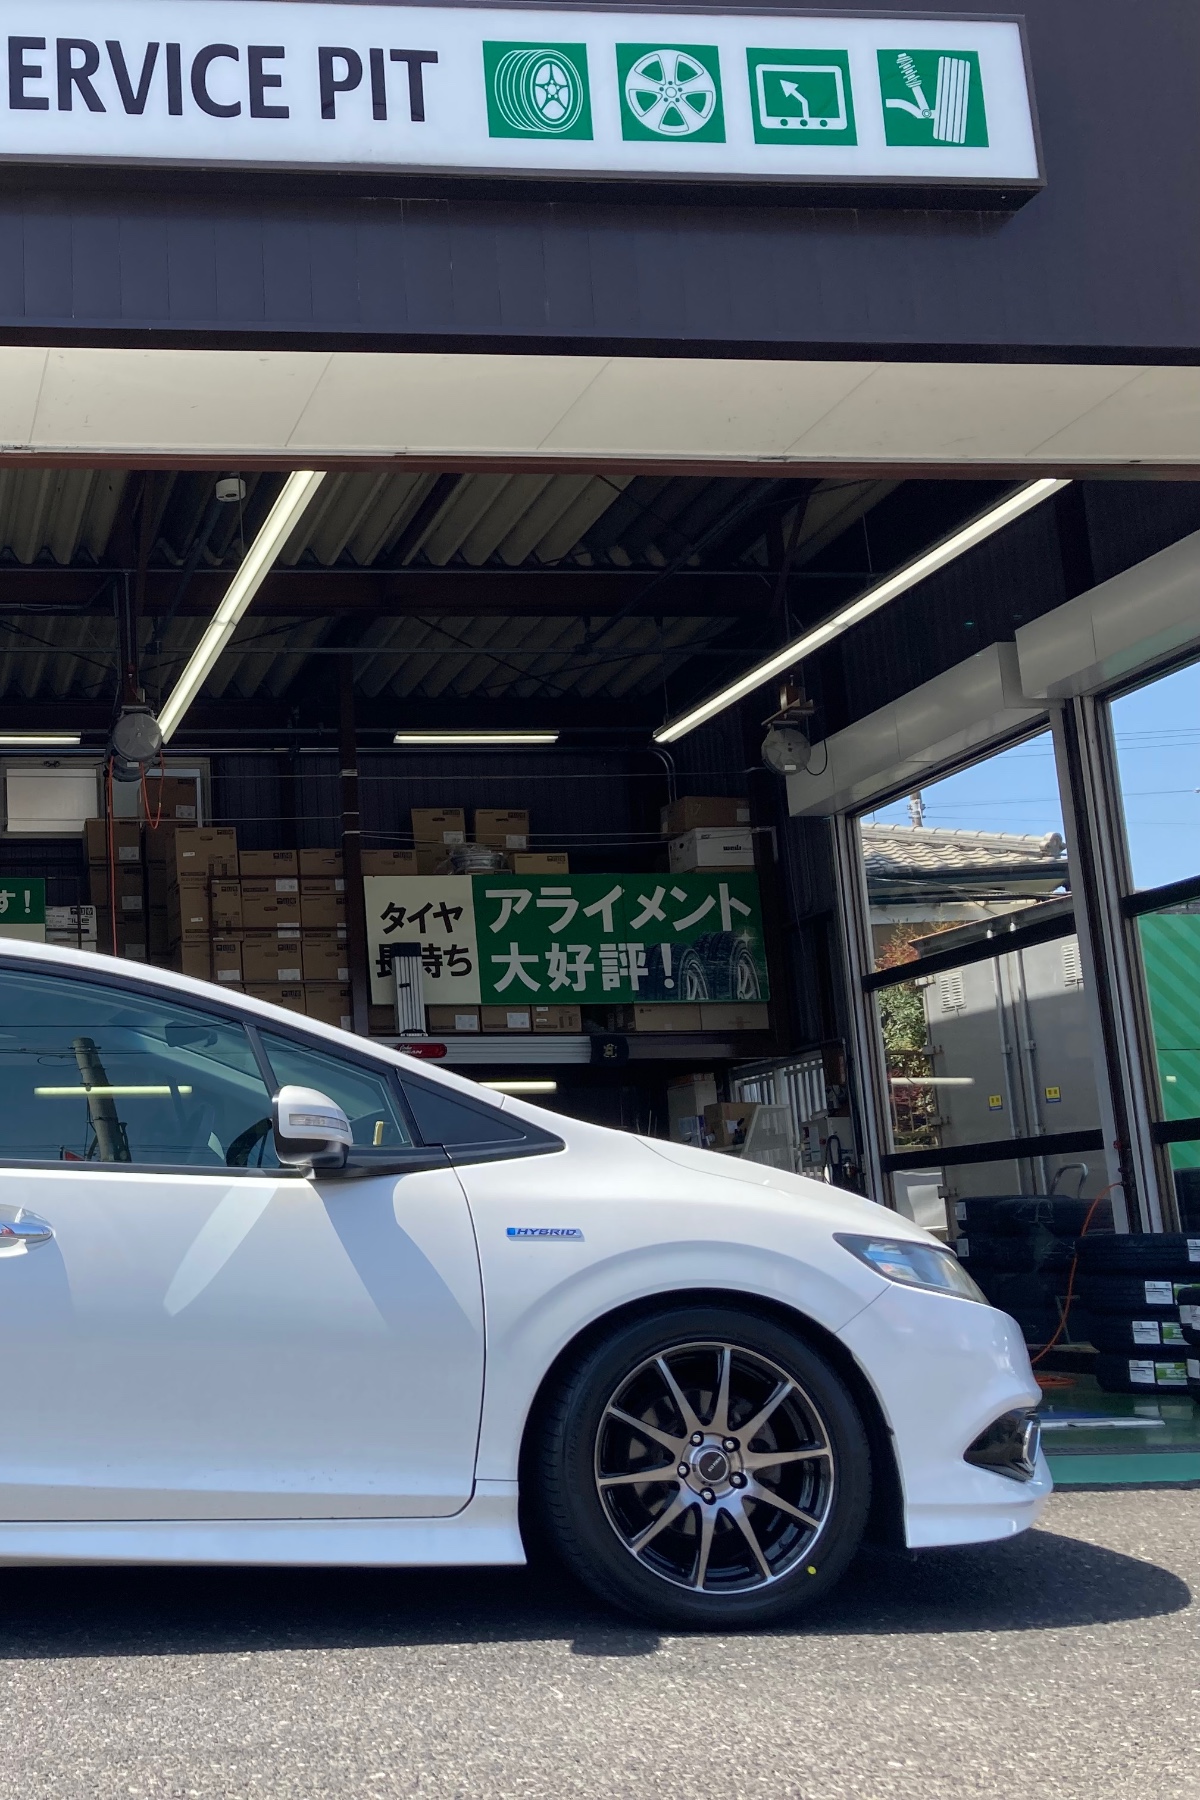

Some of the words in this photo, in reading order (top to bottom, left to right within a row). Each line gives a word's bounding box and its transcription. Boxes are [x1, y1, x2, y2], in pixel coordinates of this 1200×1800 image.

[318, 46, 439, 122] PIT
[380, 901, 464, 935] タイヤ
[485, 883, 751, 933] アライメント
[516, 1228, 577, 1236] HYBRID
